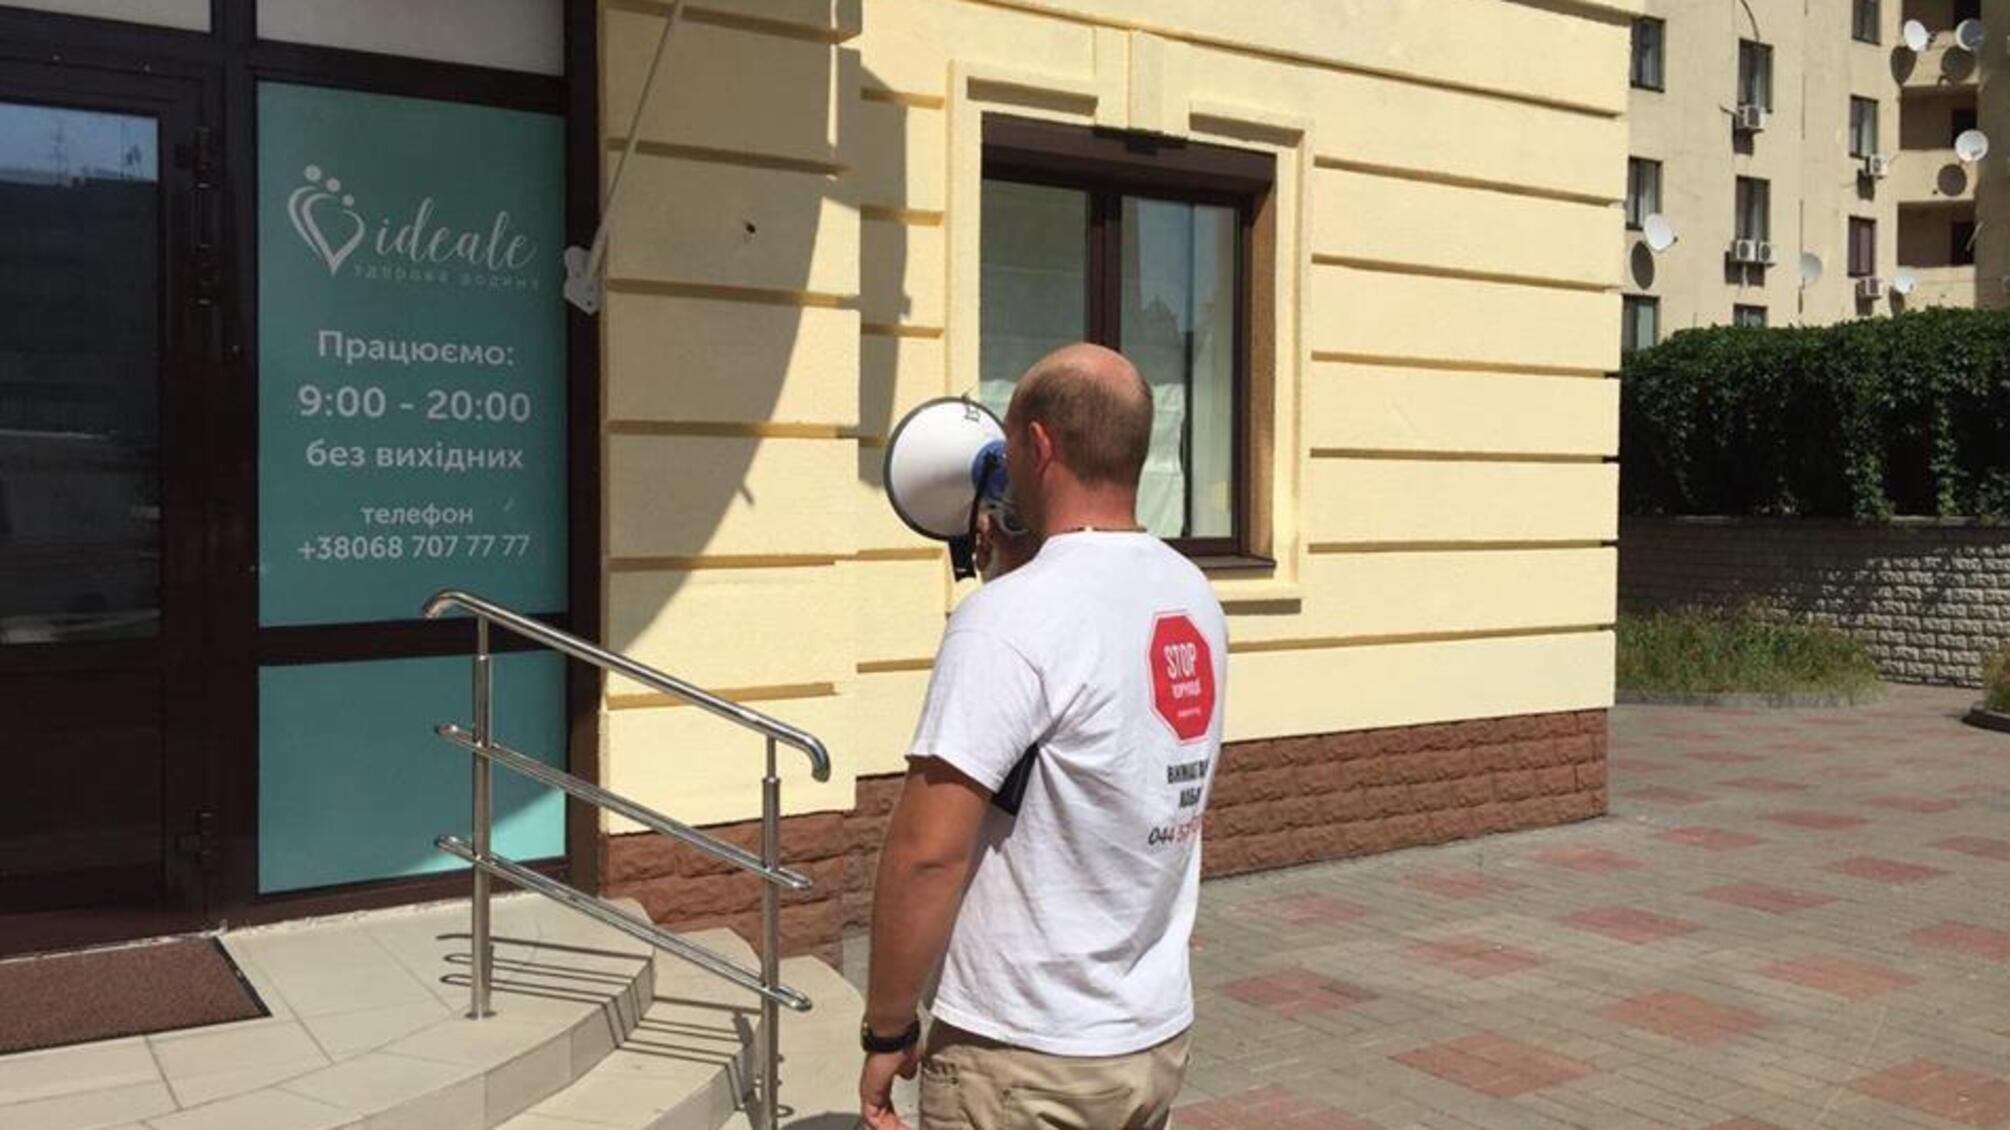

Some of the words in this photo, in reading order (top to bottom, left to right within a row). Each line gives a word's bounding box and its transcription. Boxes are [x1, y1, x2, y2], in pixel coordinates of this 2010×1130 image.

[376, 197, 538, 270] ideale
[317, 329, 514, 366] Працюємо:
[298, 384, 386, 418] 9:00
[400, 402, 414, 410] -
[426, 389, 531, 422] 20:00
[305, 438, 366, 467] без
[376, 441, 524, 472] вихідних
[361, 502, 474, 528] телефон
[298, 535, 403, 560] +38068
[411, 535, 459, 558] 707
[466, 535, 496, 557] 77
[502, 535, 531, 557] 77
[1163, 641, 1197, 680] STOP
